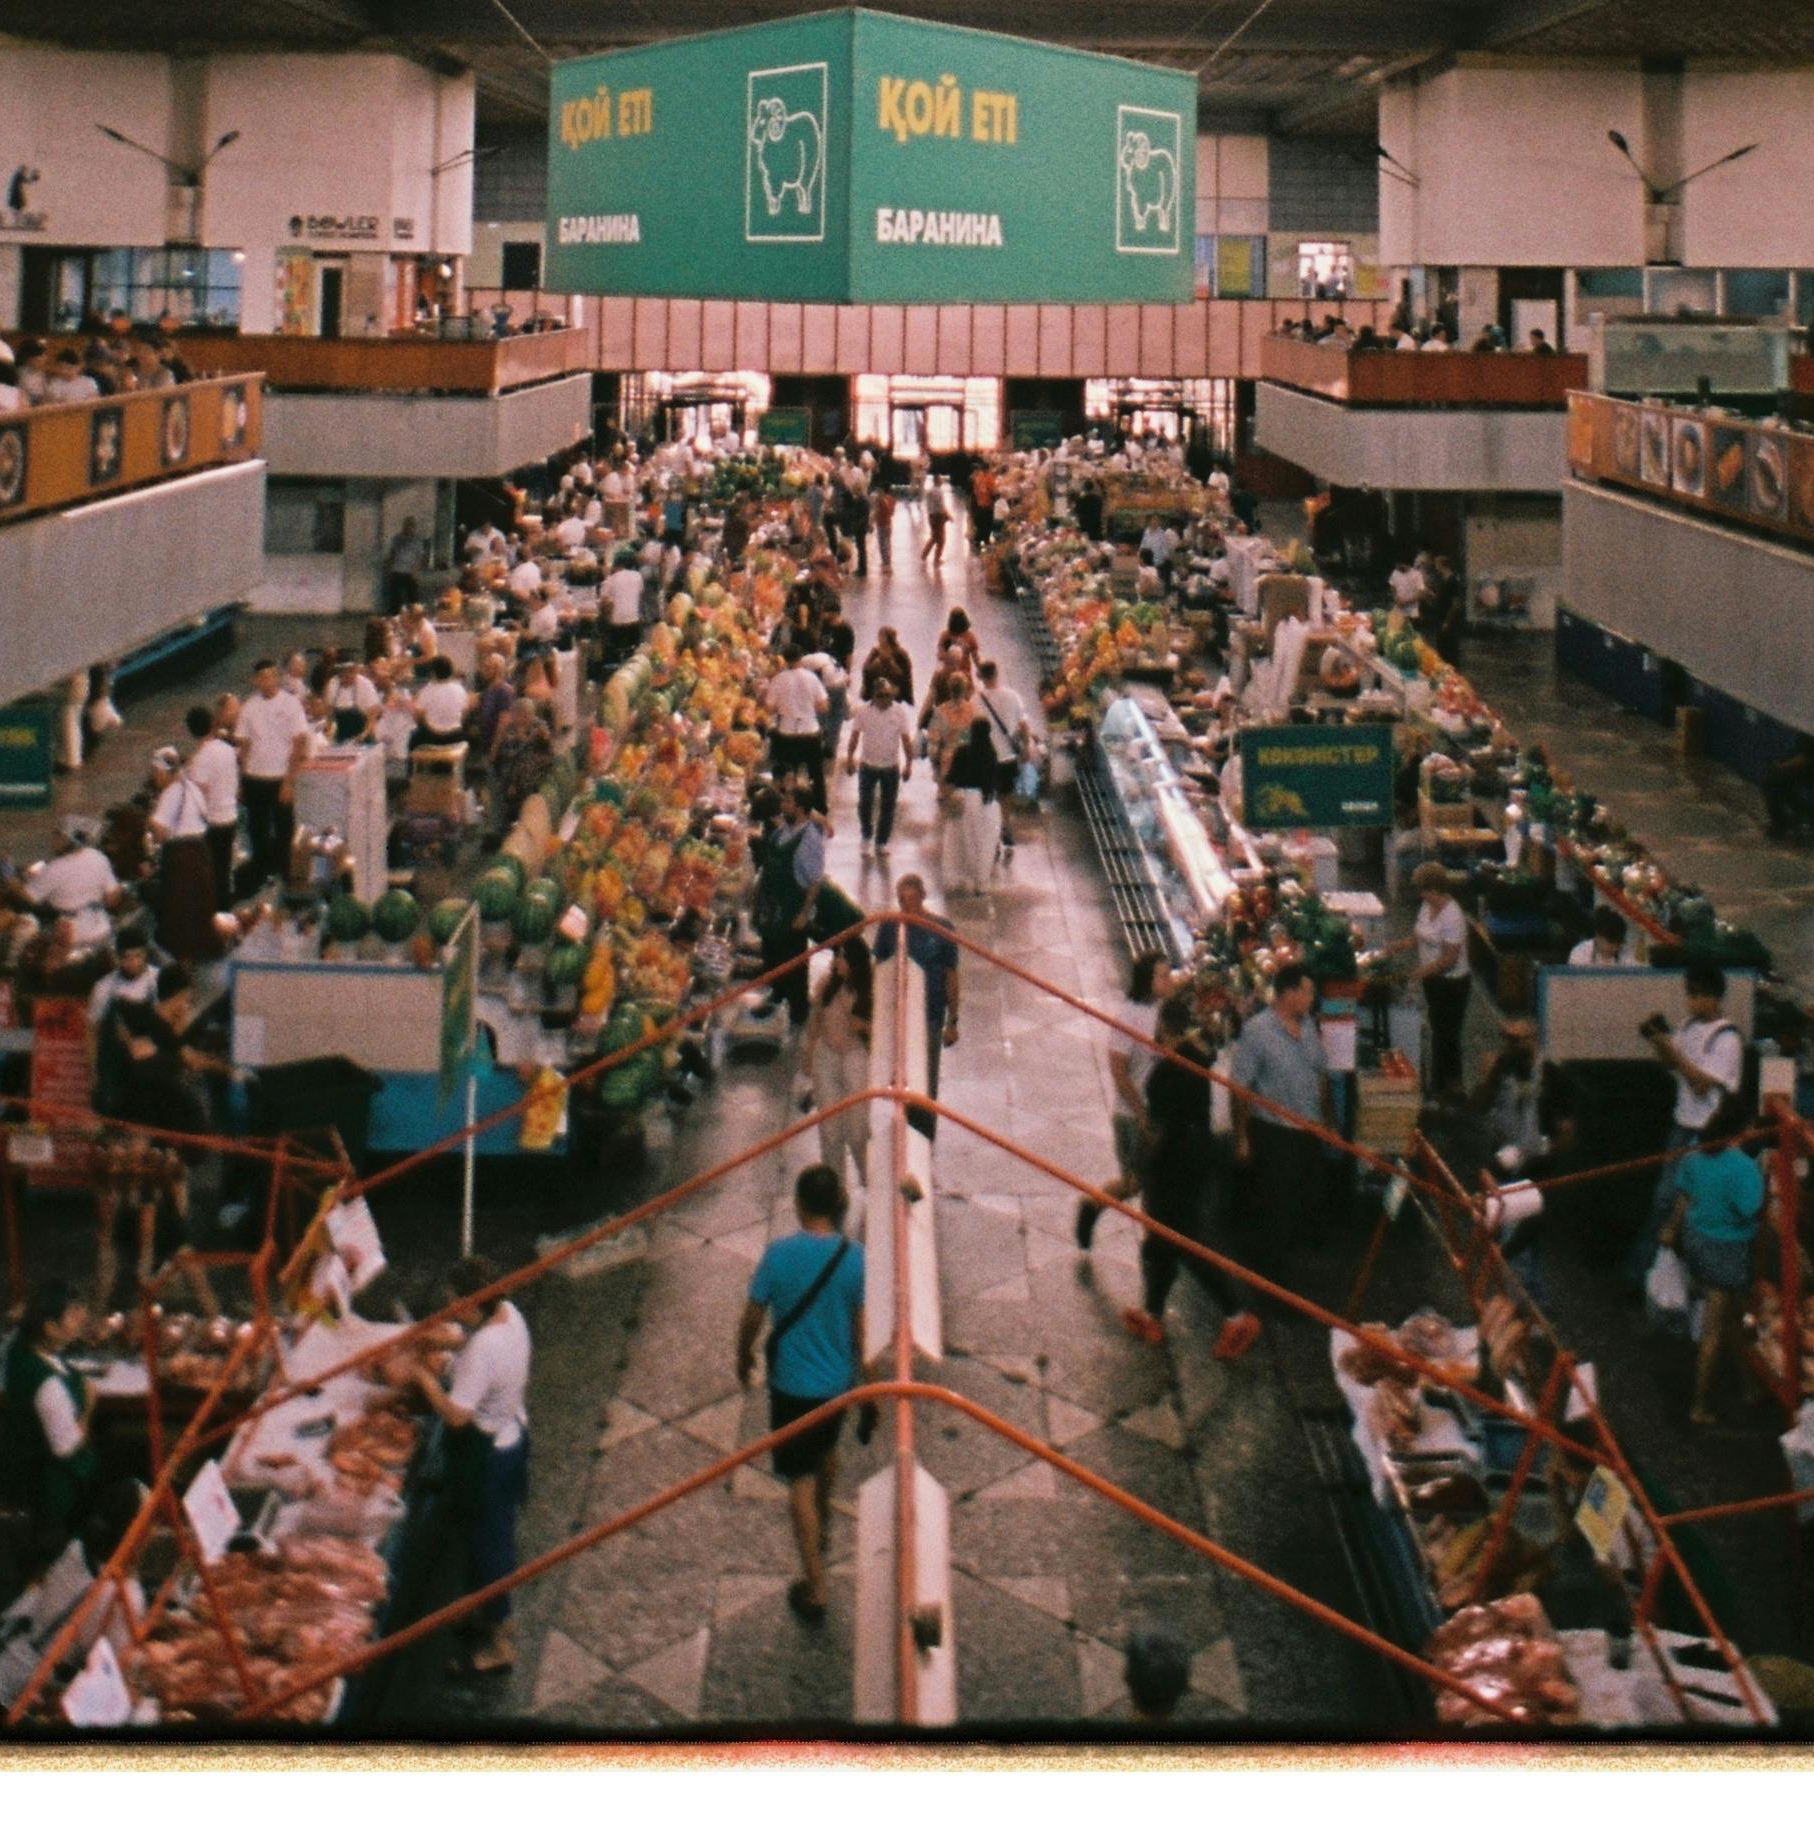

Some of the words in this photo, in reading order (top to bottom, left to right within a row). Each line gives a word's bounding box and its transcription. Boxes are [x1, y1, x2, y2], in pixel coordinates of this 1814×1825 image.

[559, 87, 611, 150] ҚОЙ
[618, 88, 653, 138] ЕТІ
[879, 75, 960, 148] ҚОЙ
[972, 92, 1017, 145] ЕТІ
[558, 214, 640, 243] БАРАНИНА
[877, 208, 1003, 247] БАРАНИНА
